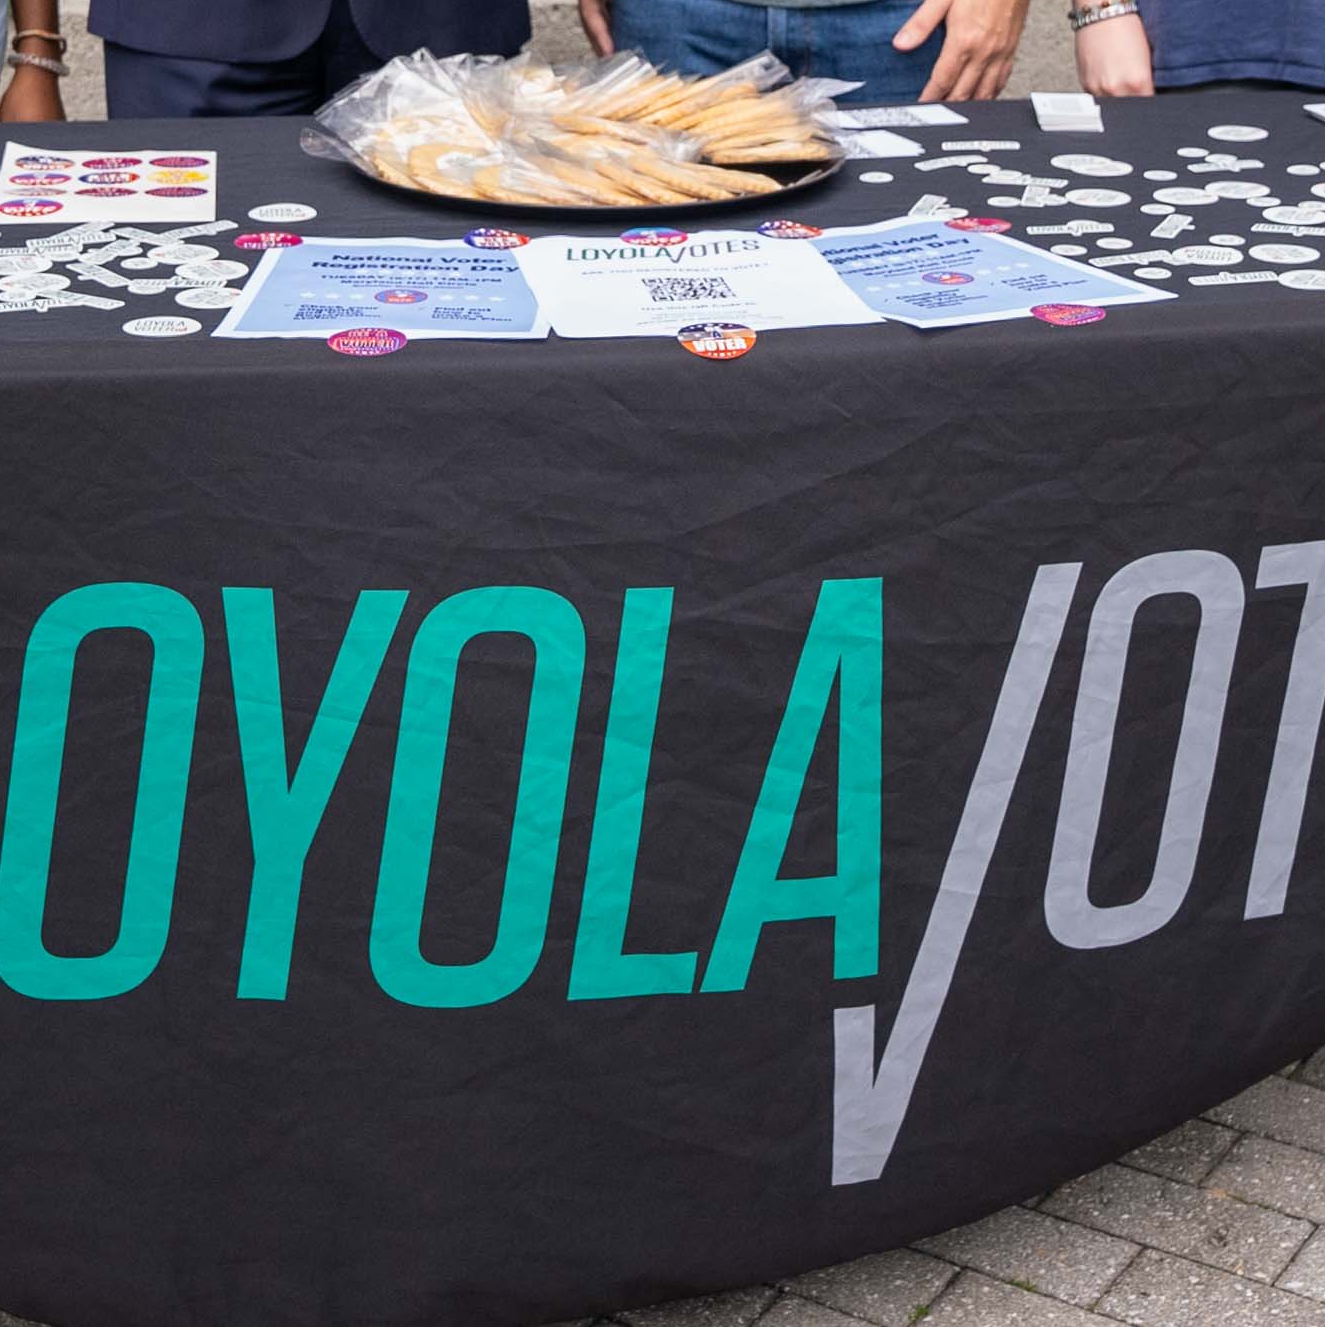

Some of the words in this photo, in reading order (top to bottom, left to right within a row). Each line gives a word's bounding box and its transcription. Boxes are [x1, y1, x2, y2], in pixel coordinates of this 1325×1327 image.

[882, 235, 939, 246] Voter
[925, 237, 970, 249] Day
[332, 255, 433, 263] National
[566, 247, 673, 261] LOYOLA
[312, 261, 459, 271] Registration
[470, 265, 520, 273] Day
[692, 337, 747, 353] VOTER
